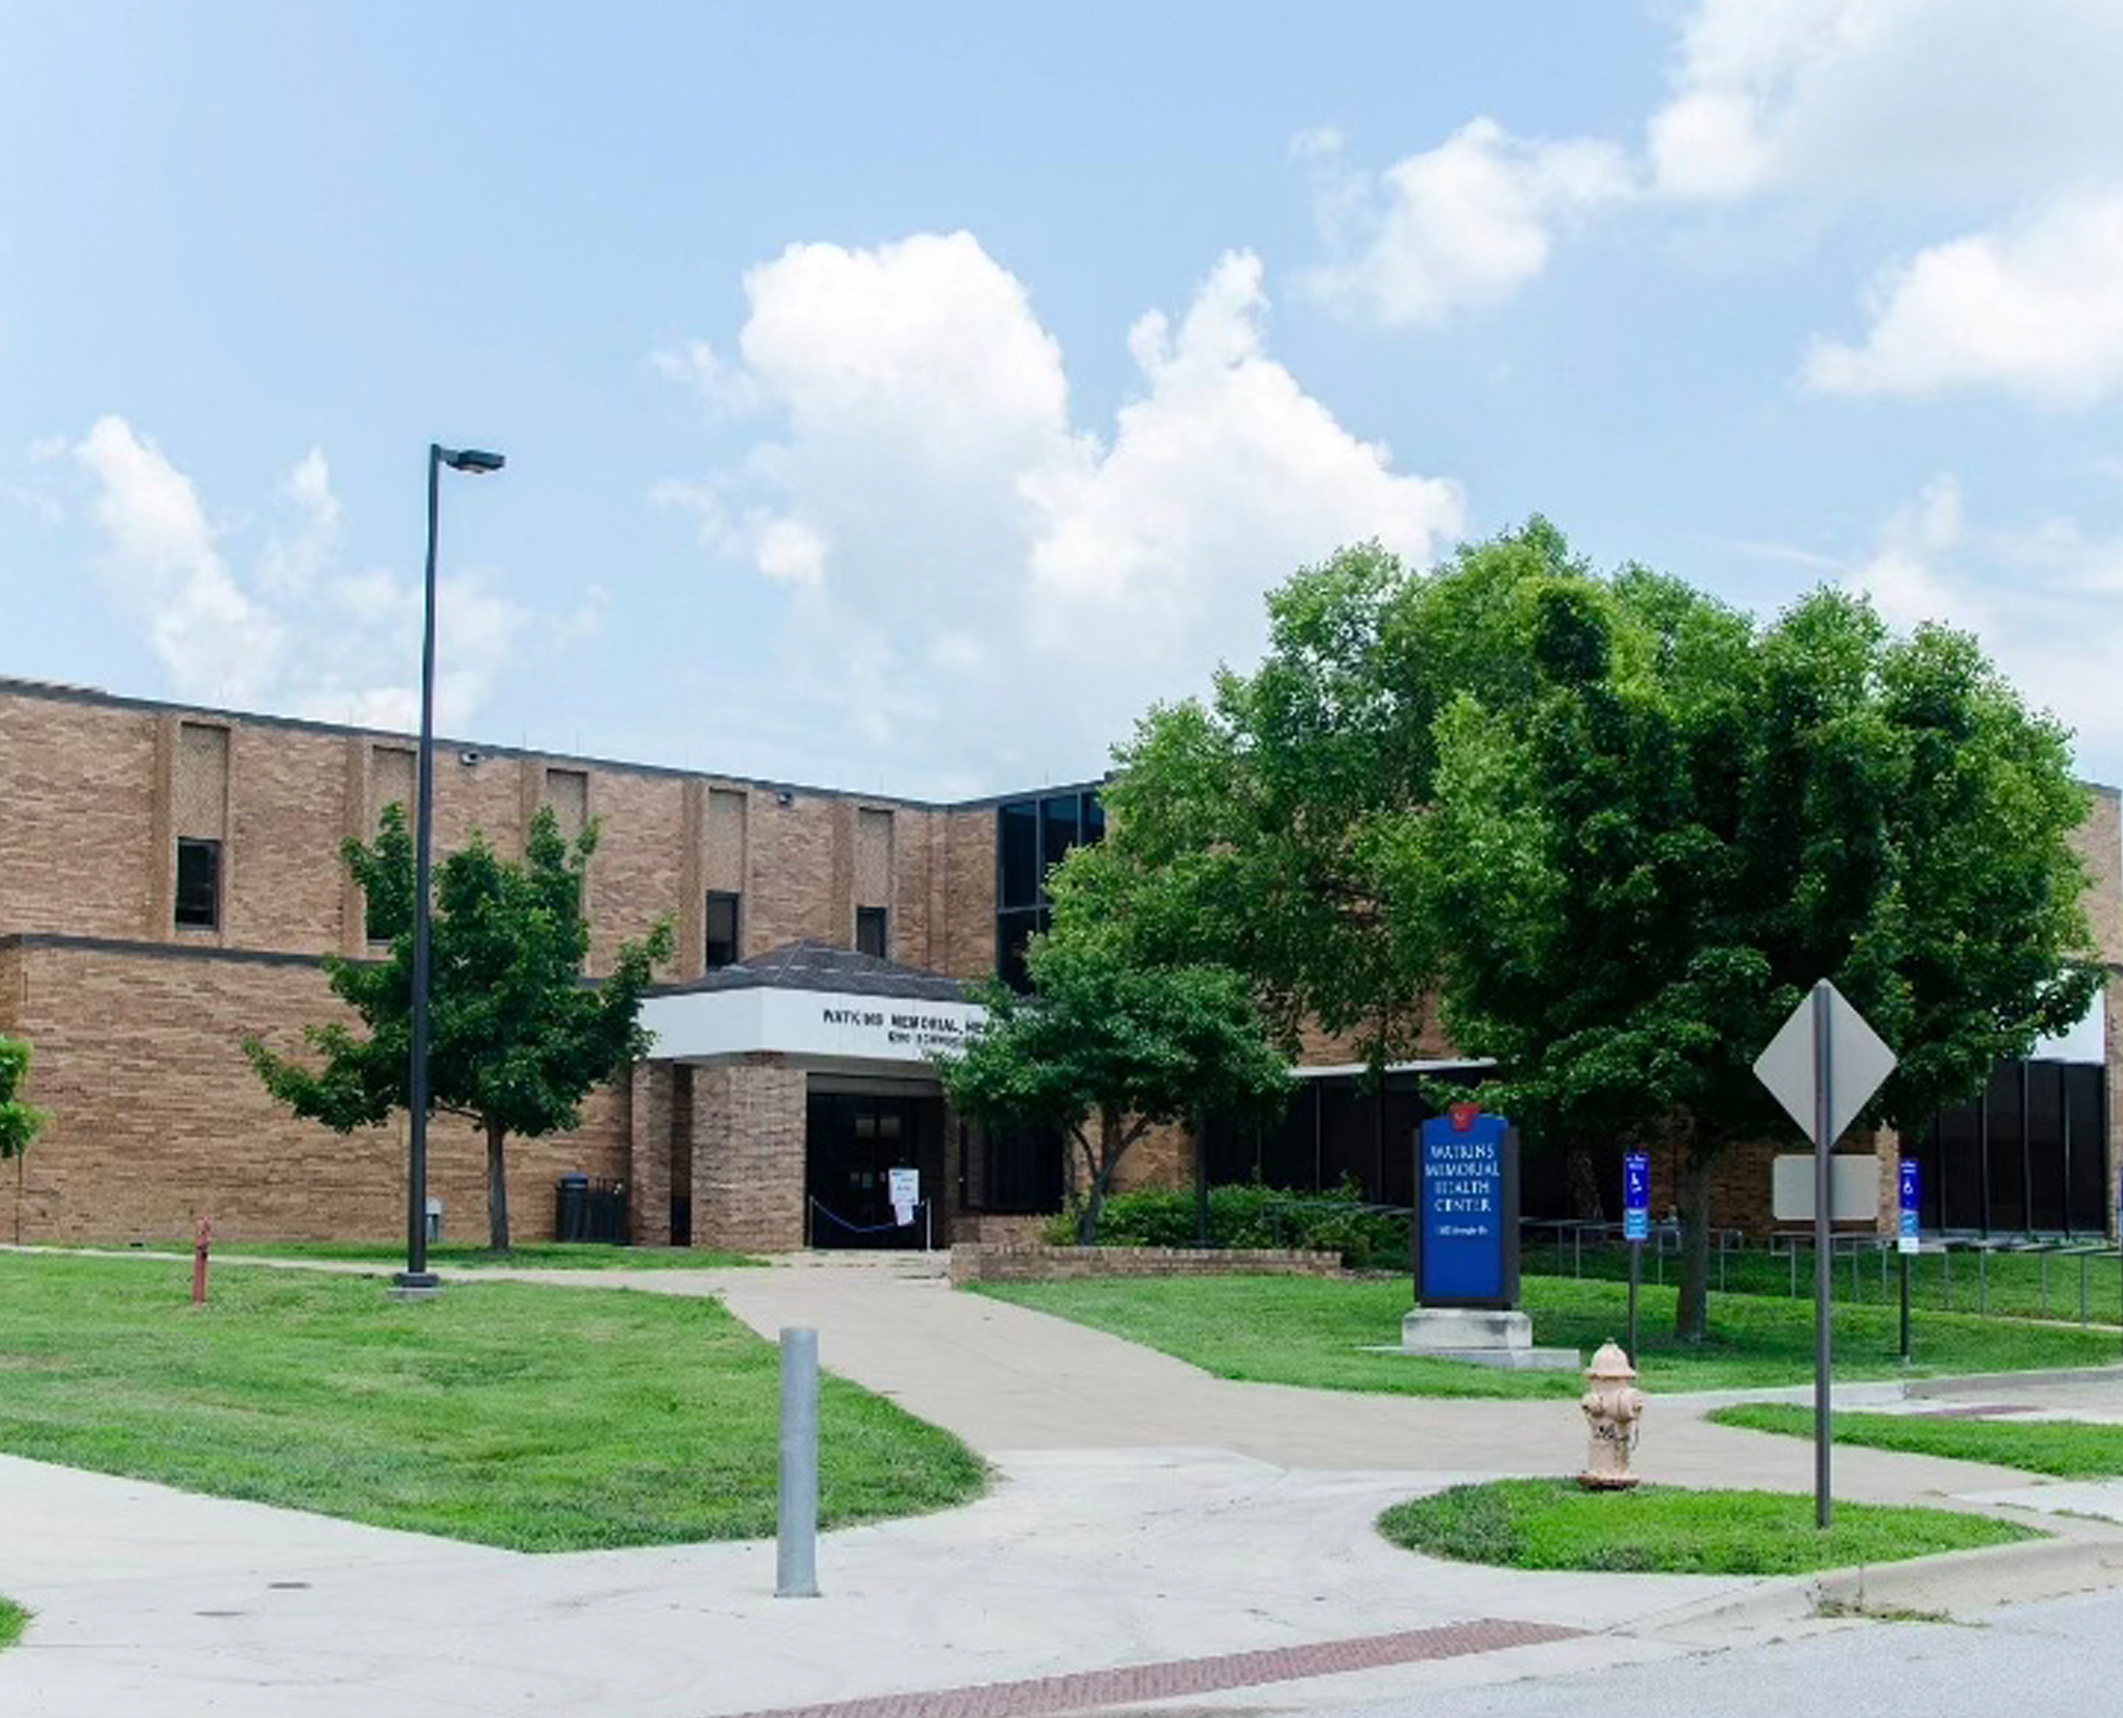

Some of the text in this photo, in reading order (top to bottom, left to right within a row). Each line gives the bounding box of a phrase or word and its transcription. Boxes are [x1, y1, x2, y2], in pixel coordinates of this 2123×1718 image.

[1430, 1144, 1495, 1159] WATKINS
[1425, 1161, 1500, 1177] MEMORIAL
[1434, 1181, 1490, 1194] HEALTH
[1434, 1198, 1491, 1212] CENTER
